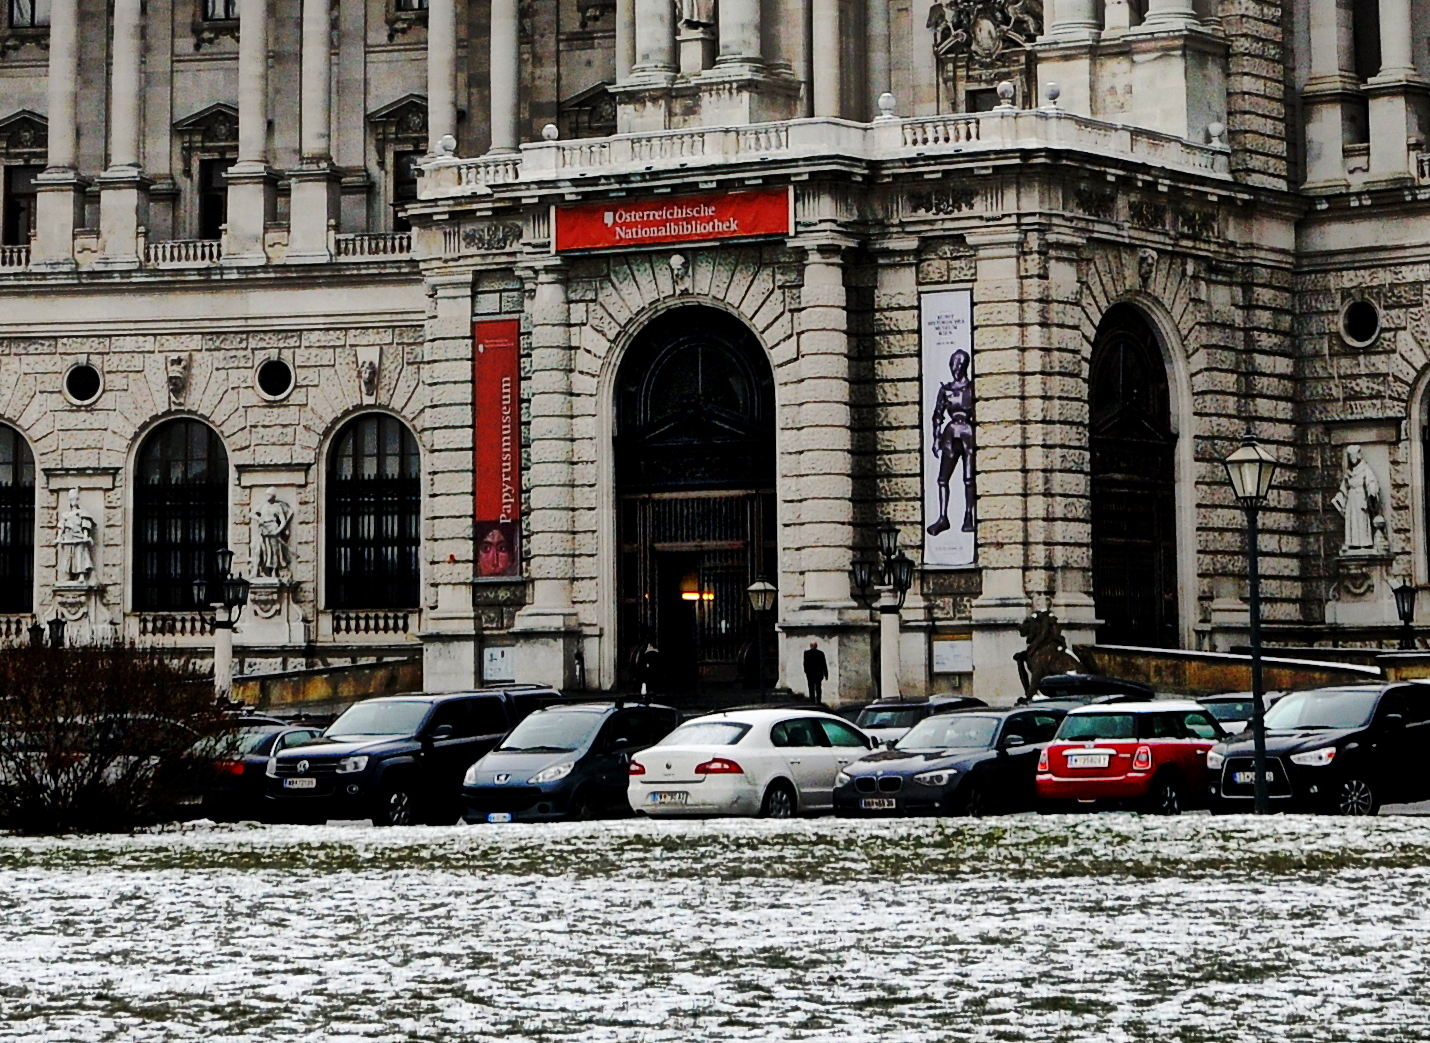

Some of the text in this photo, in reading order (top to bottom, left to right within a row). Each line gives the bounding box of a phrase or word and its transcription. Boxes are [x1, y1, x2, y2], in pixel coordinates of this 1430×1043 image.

[615, 204, 716, 223] Österreichische
[615, 217, 738, 239] Nationalbibliothek
[500, 377, 514, 523] Papyrusmuseum
